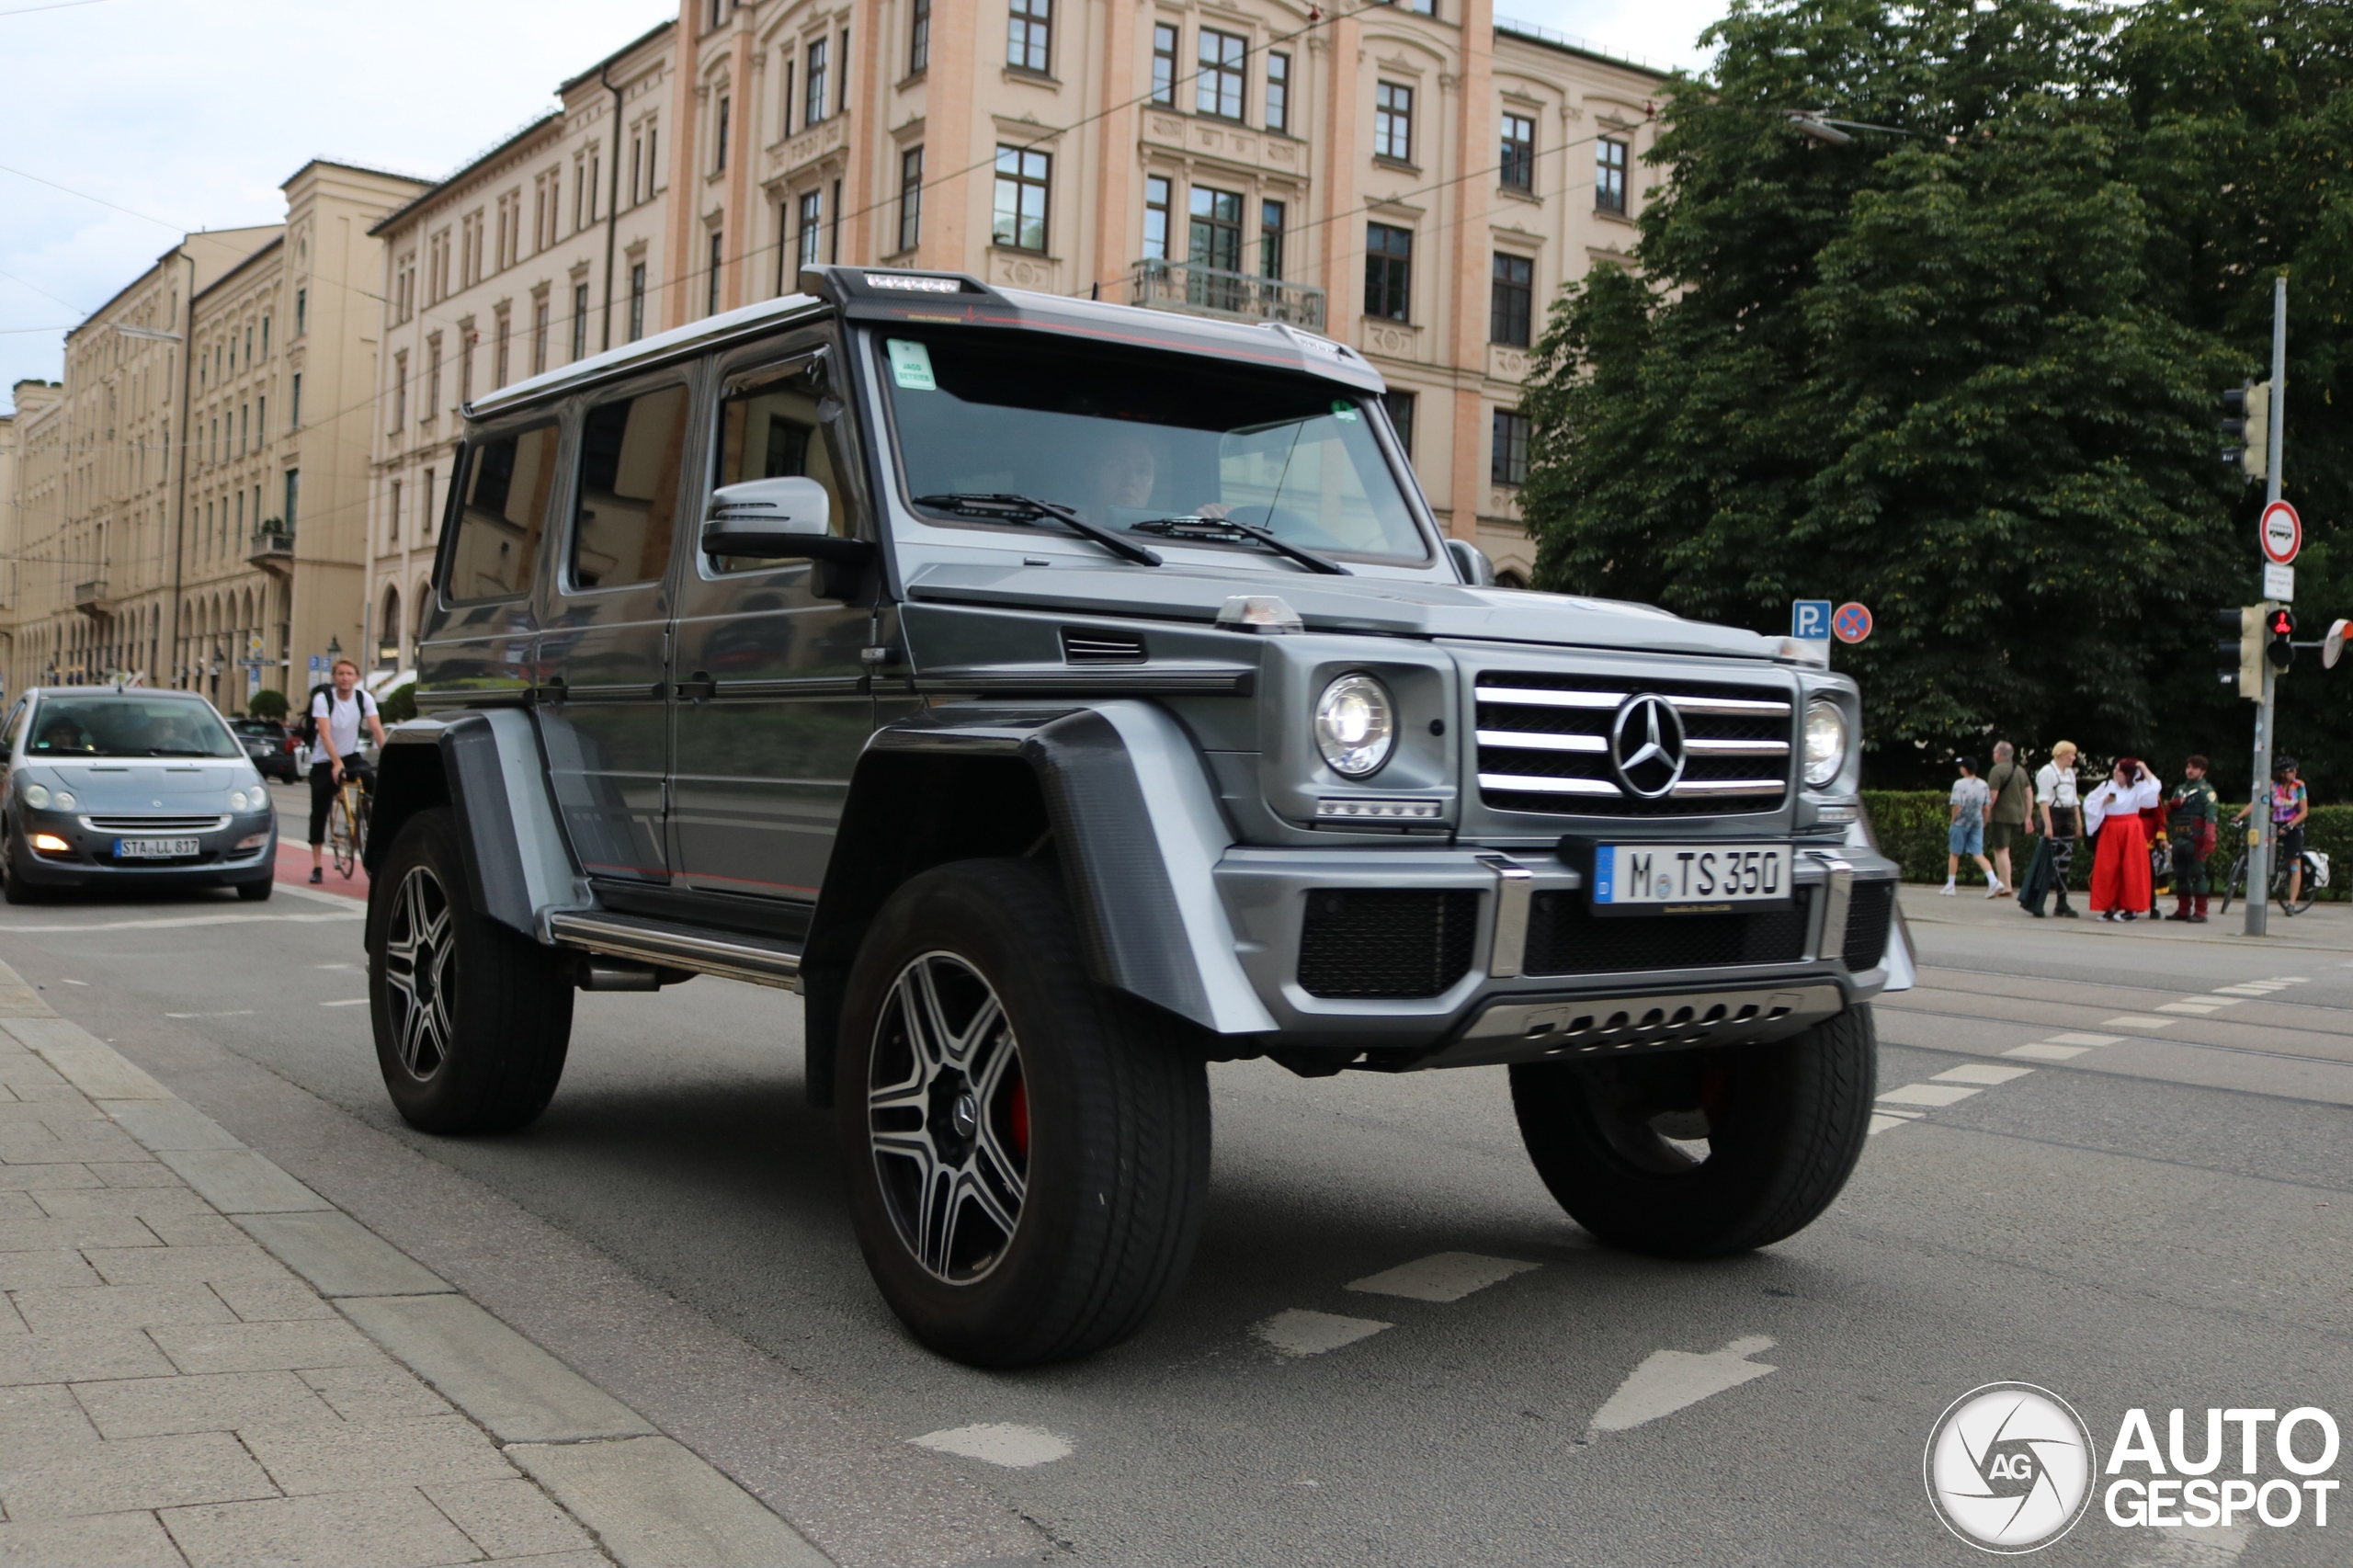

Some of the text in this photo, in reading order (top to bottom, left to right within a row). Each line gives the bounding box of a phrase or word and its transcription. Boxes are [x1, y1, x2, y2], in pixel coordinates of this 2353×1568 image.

[1799, 606, 1819, 635] P
[123, 841, 198, 854] STA LL 817
[1631, 851, 1779, 897] M TS 350
